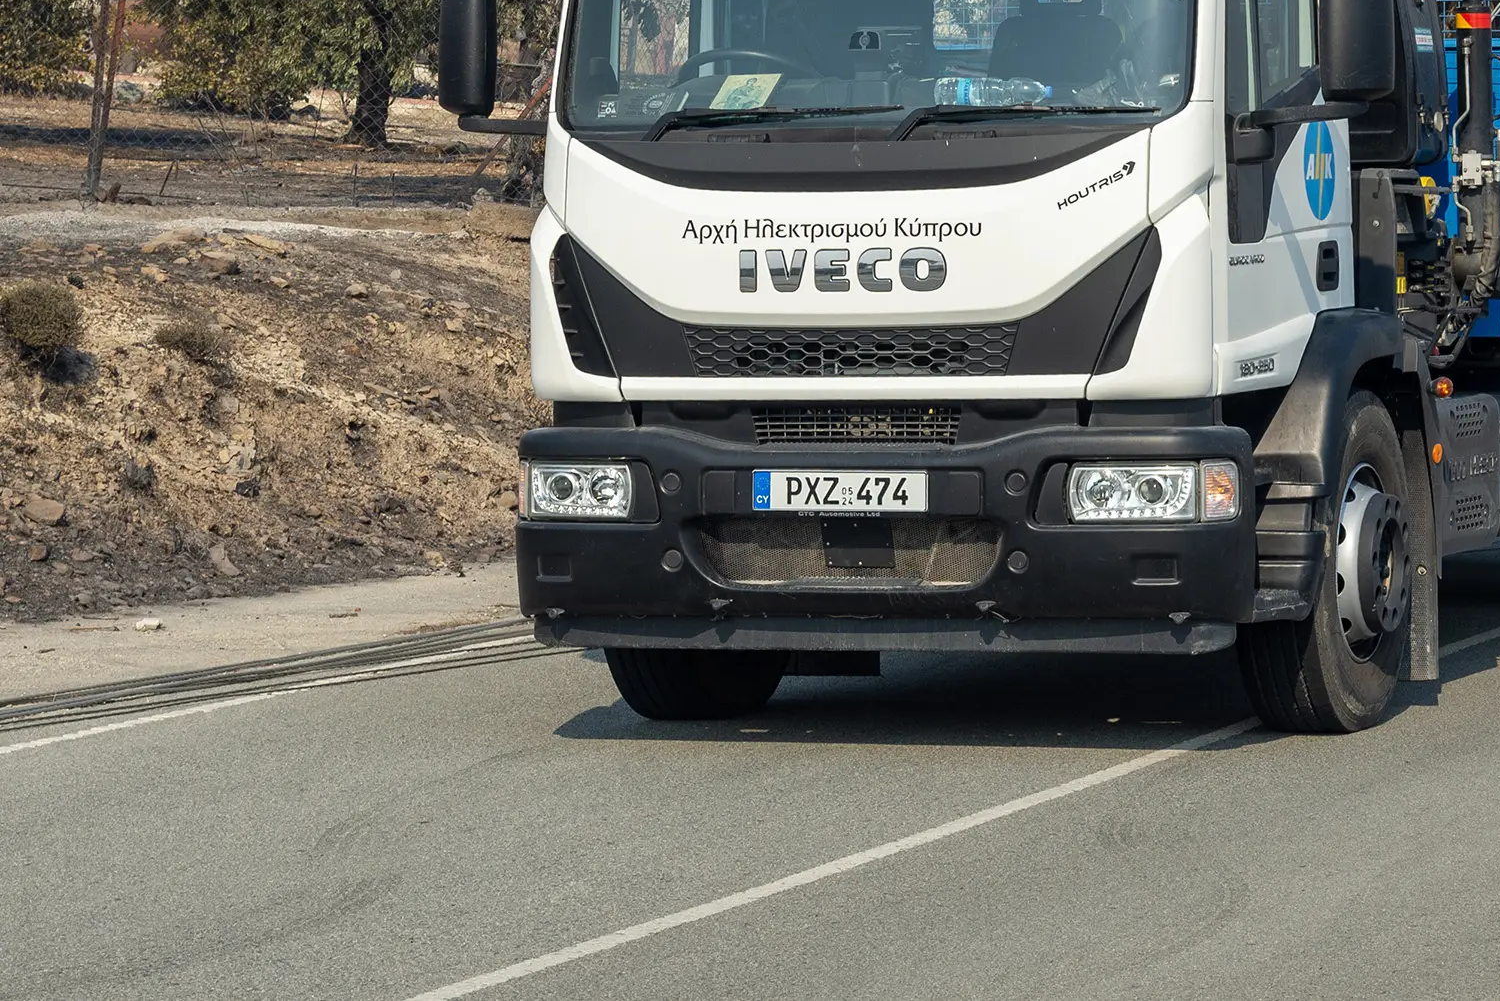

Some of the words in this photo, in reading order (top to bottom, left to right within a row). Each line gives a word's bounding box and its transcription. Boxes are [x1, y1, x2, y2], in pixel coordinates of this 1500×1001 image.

[1056, 170, 1125, 211] HOUTRIS
[682, 220, 738, 245] Αρχή
[744, 217, 887, 243] Ηλεκτρισμού
[893, 216, 983, 241] Κύπρου
[738, 247, 948, 293] IVECO
[756, 495, 769, 503] CY
[785, 477, 840, 505] PXZ
[856, 477, 909, 506] 474
[841, 487, 854, 495] 05
[841, 497, 853, 505] 24
